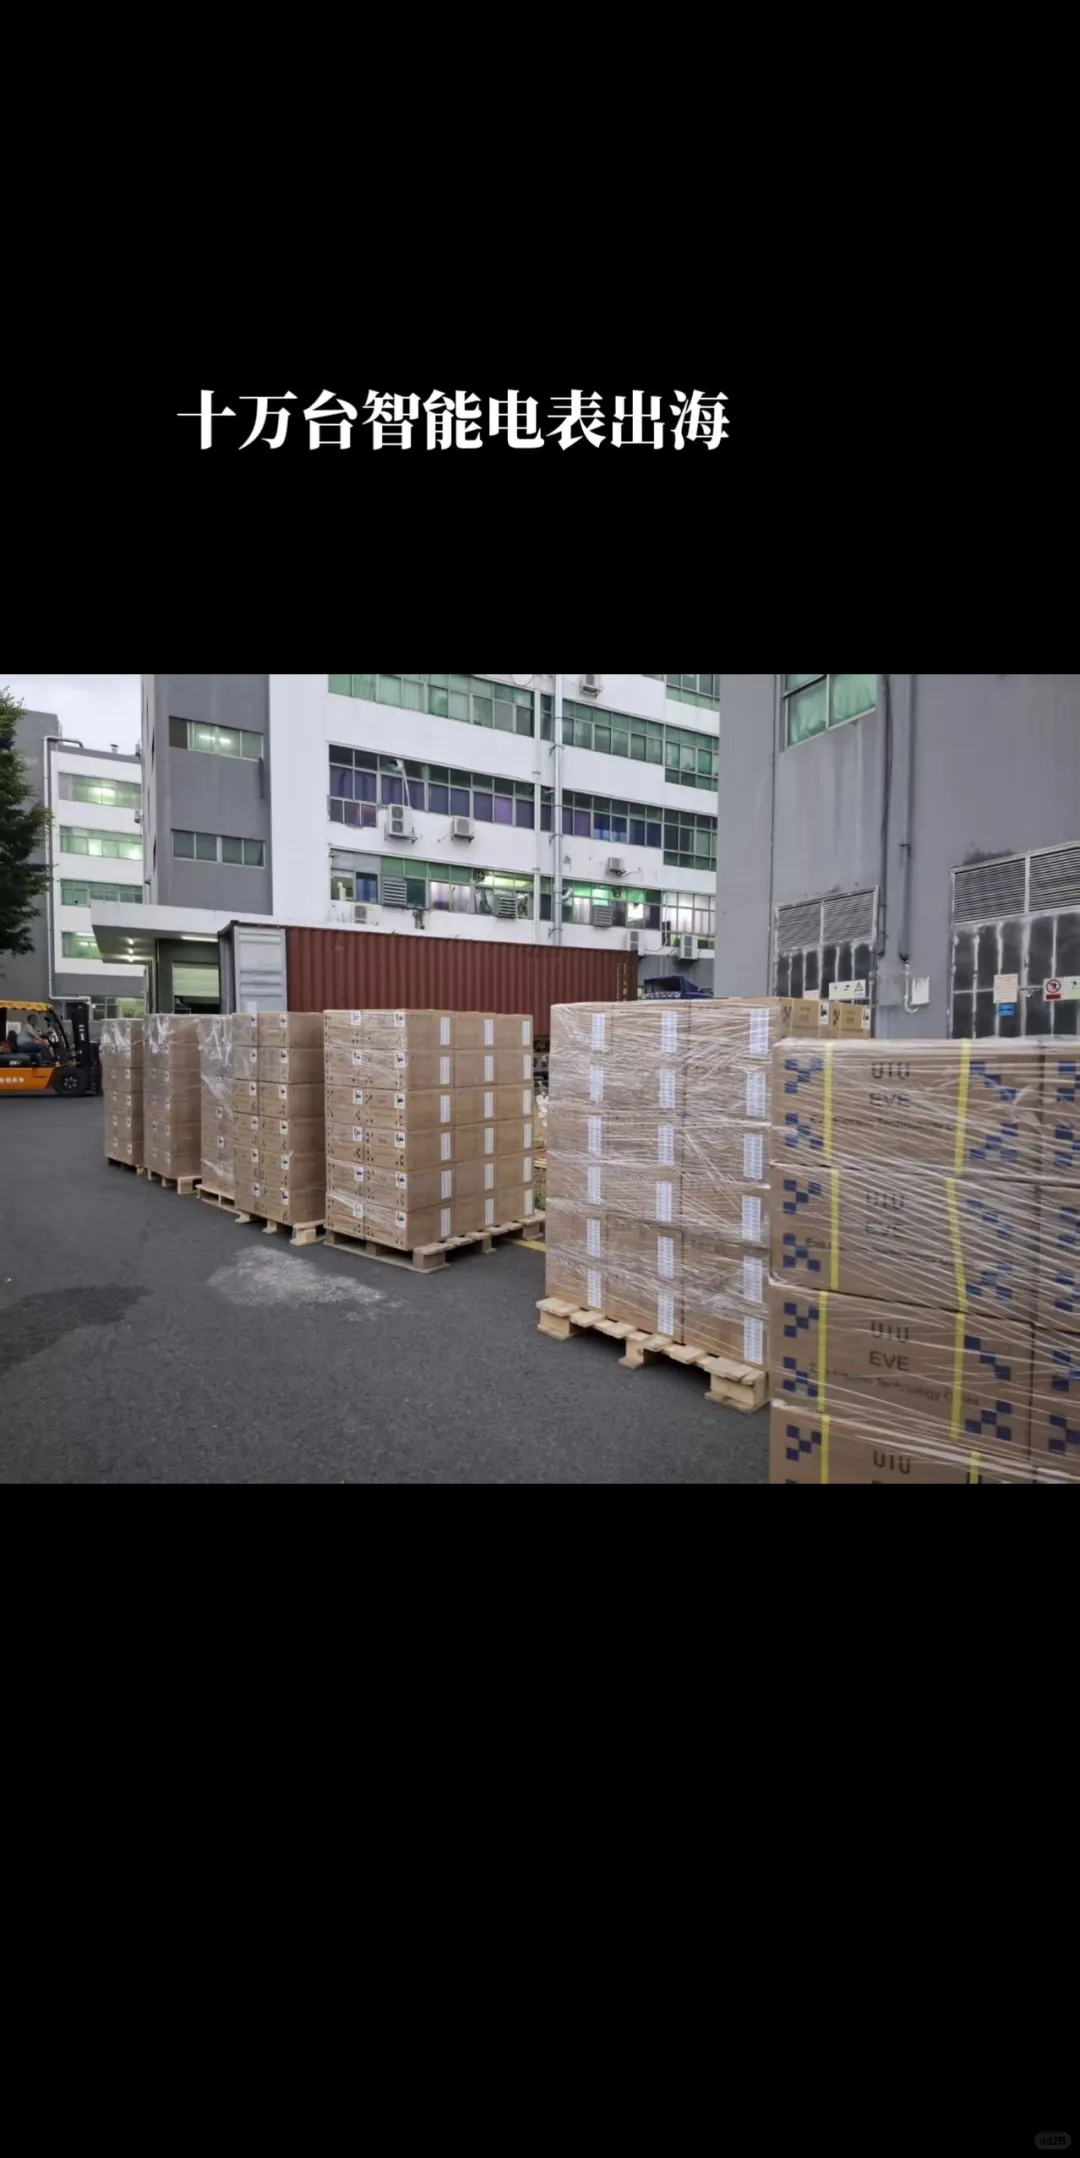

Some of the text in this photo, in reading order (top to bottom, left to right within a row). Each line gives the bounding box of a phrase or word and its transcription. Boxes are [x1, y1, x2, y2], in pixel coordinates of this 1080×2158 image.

[869, 1092, 911, 1108] EVE
[869, 1350, 910, 1373] EVE
[872, 1449, 912, 1475] UIU
